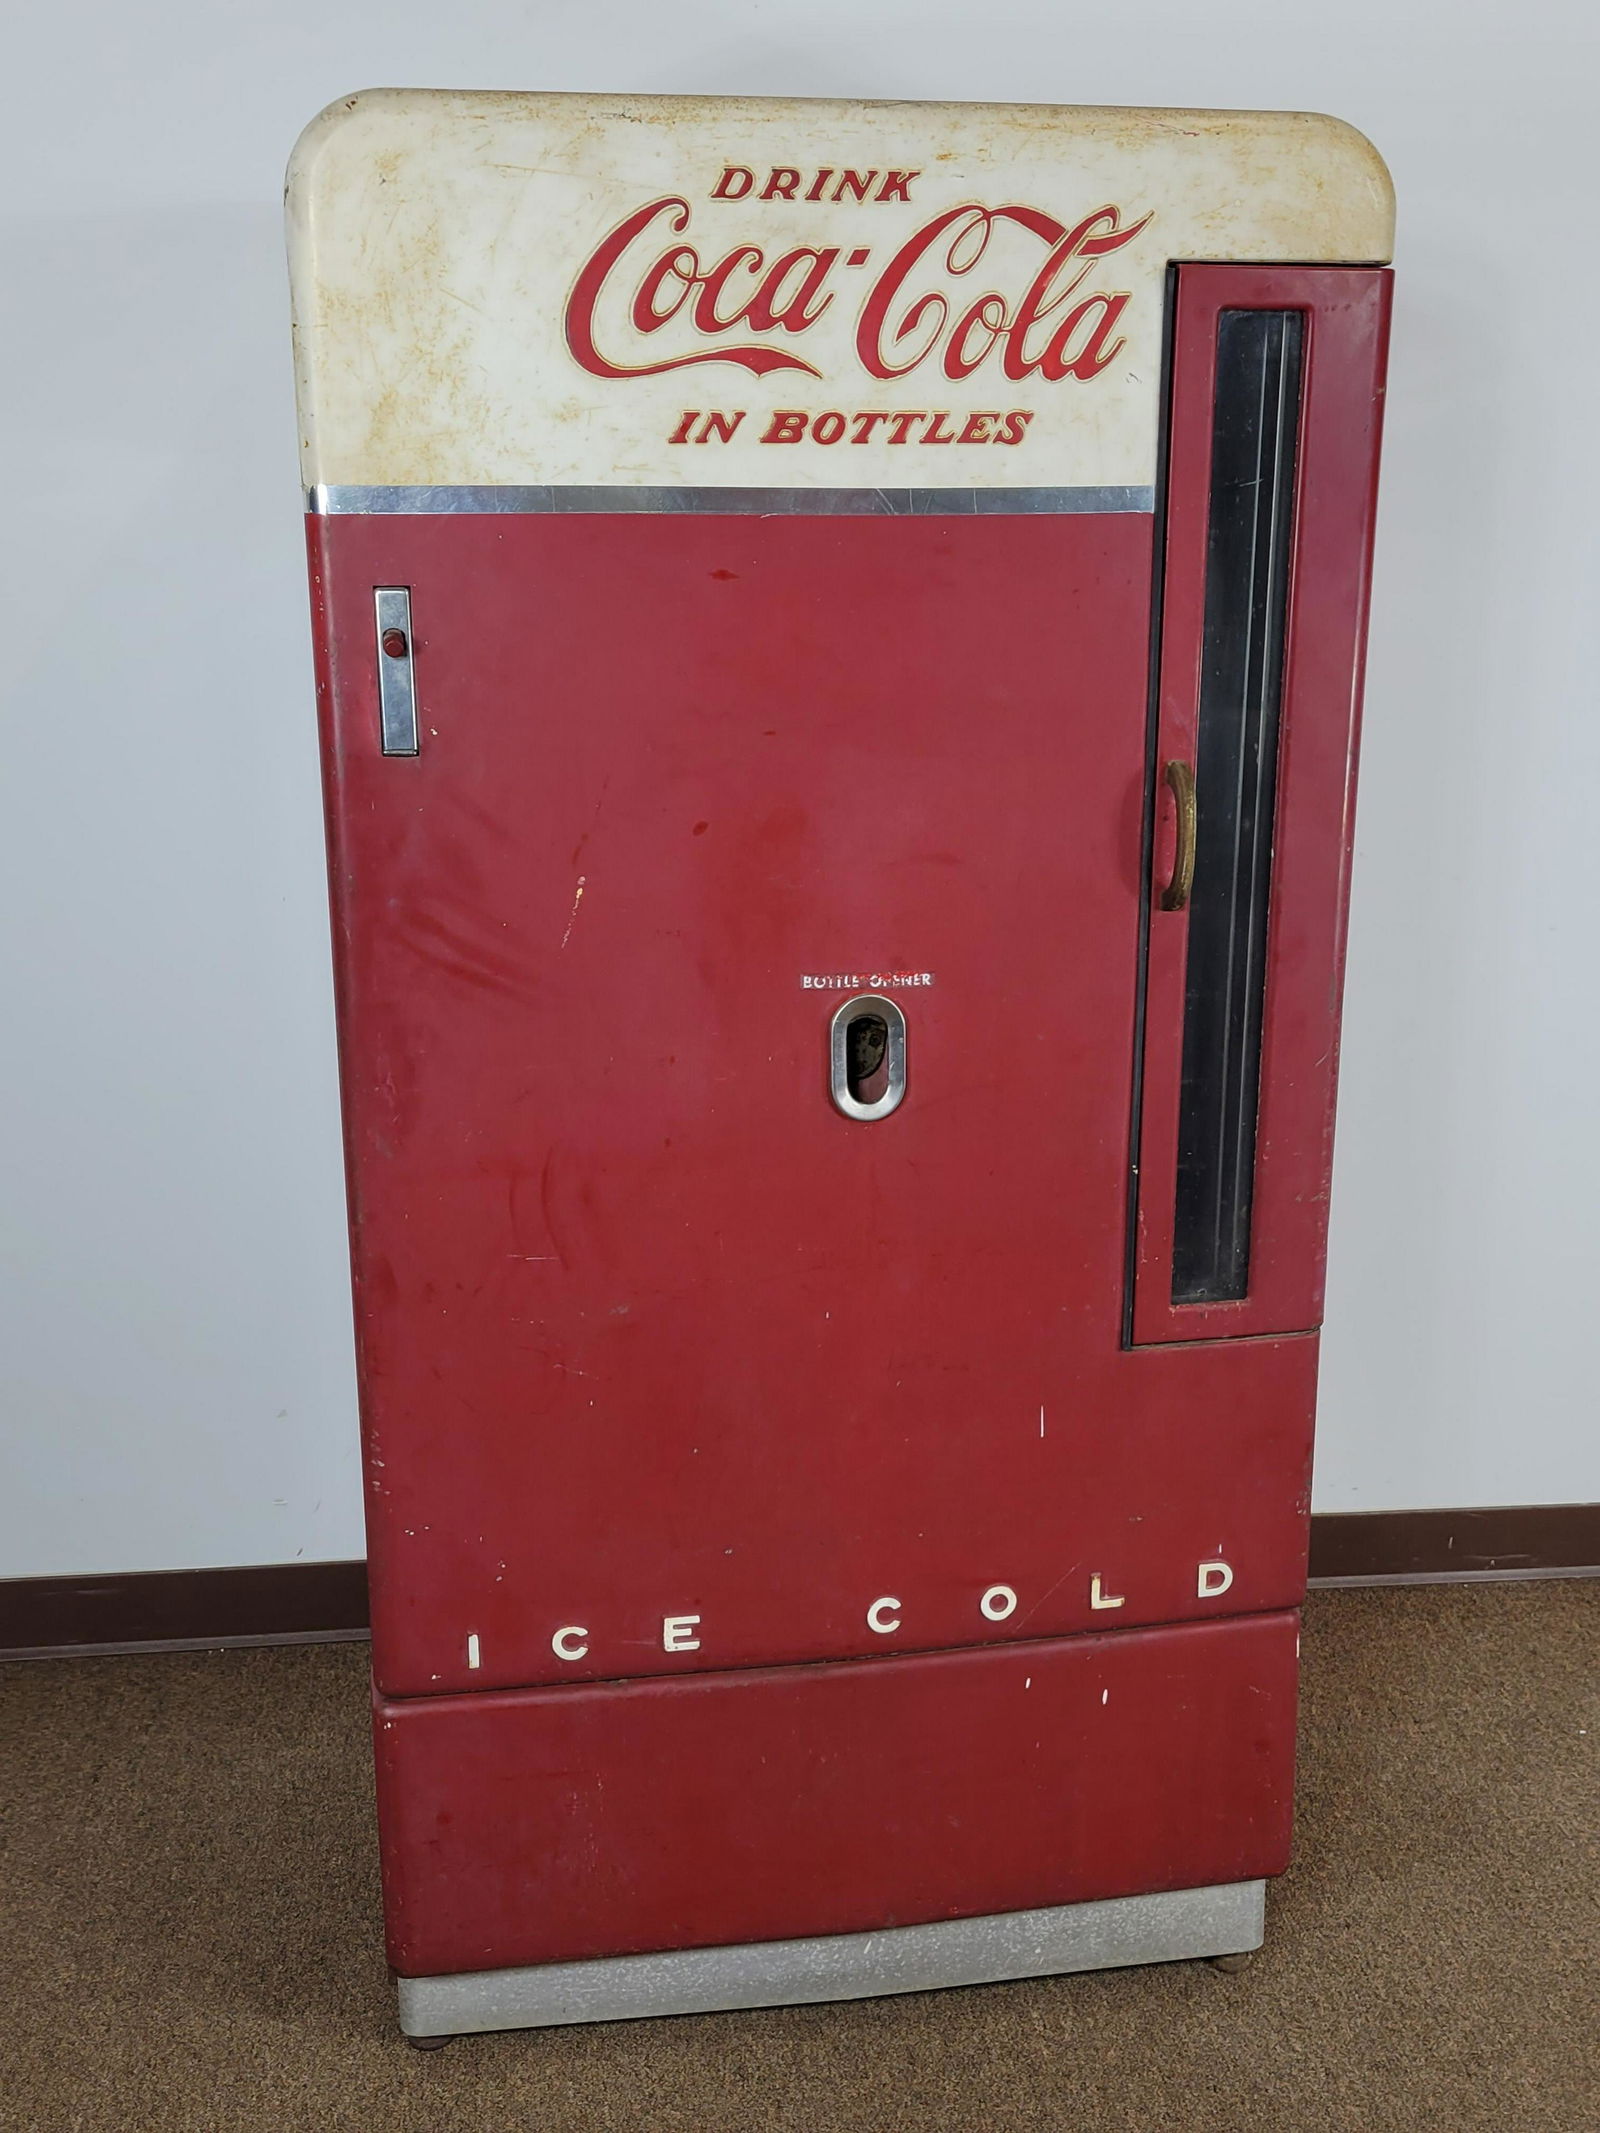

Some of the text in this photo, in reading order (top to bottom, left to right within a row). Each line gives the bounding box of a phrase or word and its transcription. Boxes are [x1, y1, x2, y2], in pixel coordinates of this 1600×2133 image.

[711, 166, 921, 202] DRINK
[564, 197, 1156, 383] Coca-Cola
[668, 409, 1035, 444] IN BOTTLES
[803, 975, 860, 989] BOTTLE
[466, 1562, 1234, 1670] ICE COLD
